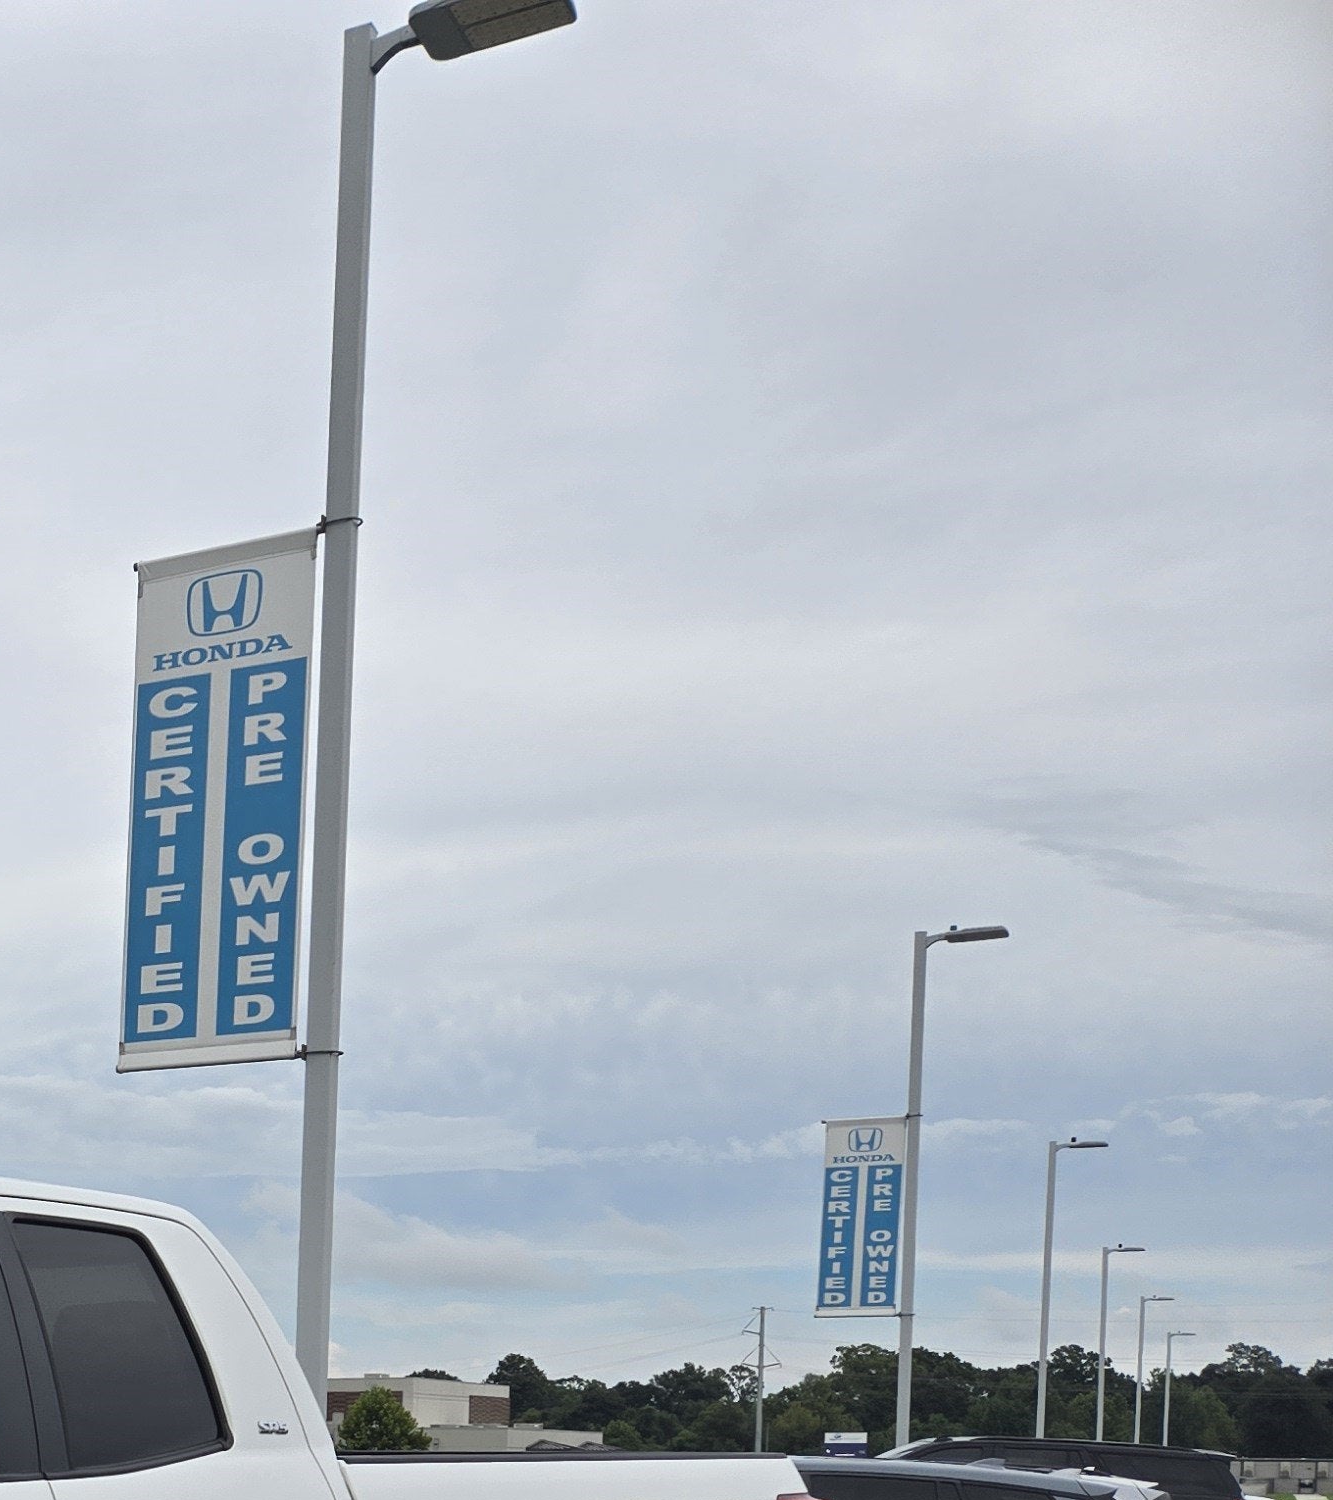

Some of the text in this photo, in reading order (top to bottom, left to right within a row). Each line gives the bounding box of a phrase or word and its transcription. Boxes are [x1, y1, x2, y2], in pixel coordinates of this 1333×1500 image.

[152, 634, 293, 671] HONDA
[136, 686, 199, 1034] CERTIFIED
[229, 671, 290, 1026] PRE OWNED
[833, 1153, 895, 1164] HONDA
[823, 1170, 853, 1305] CERTIFIED
[866, 1168, 894, 1304] PRE OWNED
